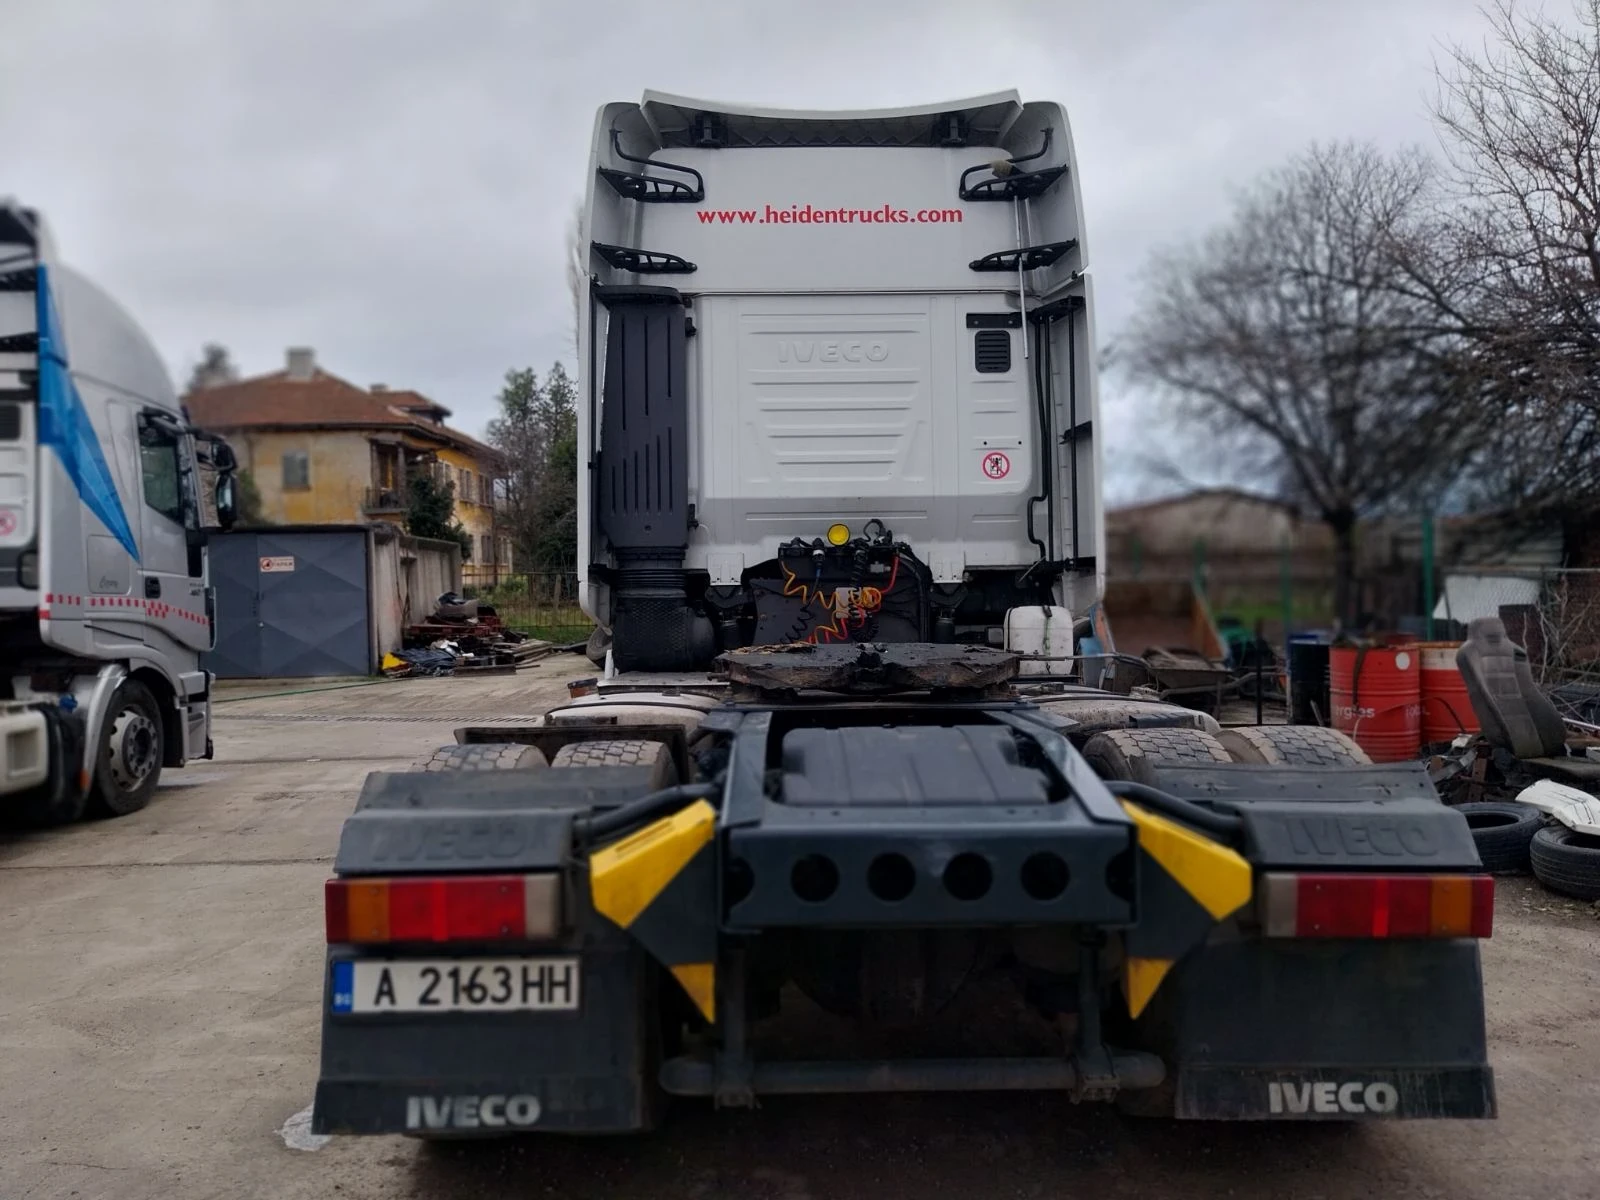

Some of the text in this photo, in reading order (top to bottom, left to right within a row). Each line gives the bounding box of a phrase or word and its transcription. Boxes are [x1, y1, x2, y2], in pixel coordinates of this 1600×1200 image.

[697, 205, 962, 224] www.heidentrucks.com
[778, 340, 889, 363] IVECO
[1285, 817, 1438, 856] IVECO
[374, 966, 397, 1006] A
[406, 1095, 541, 1128] IVECO
[1268, 1082, 1399, 1113] IVECO
